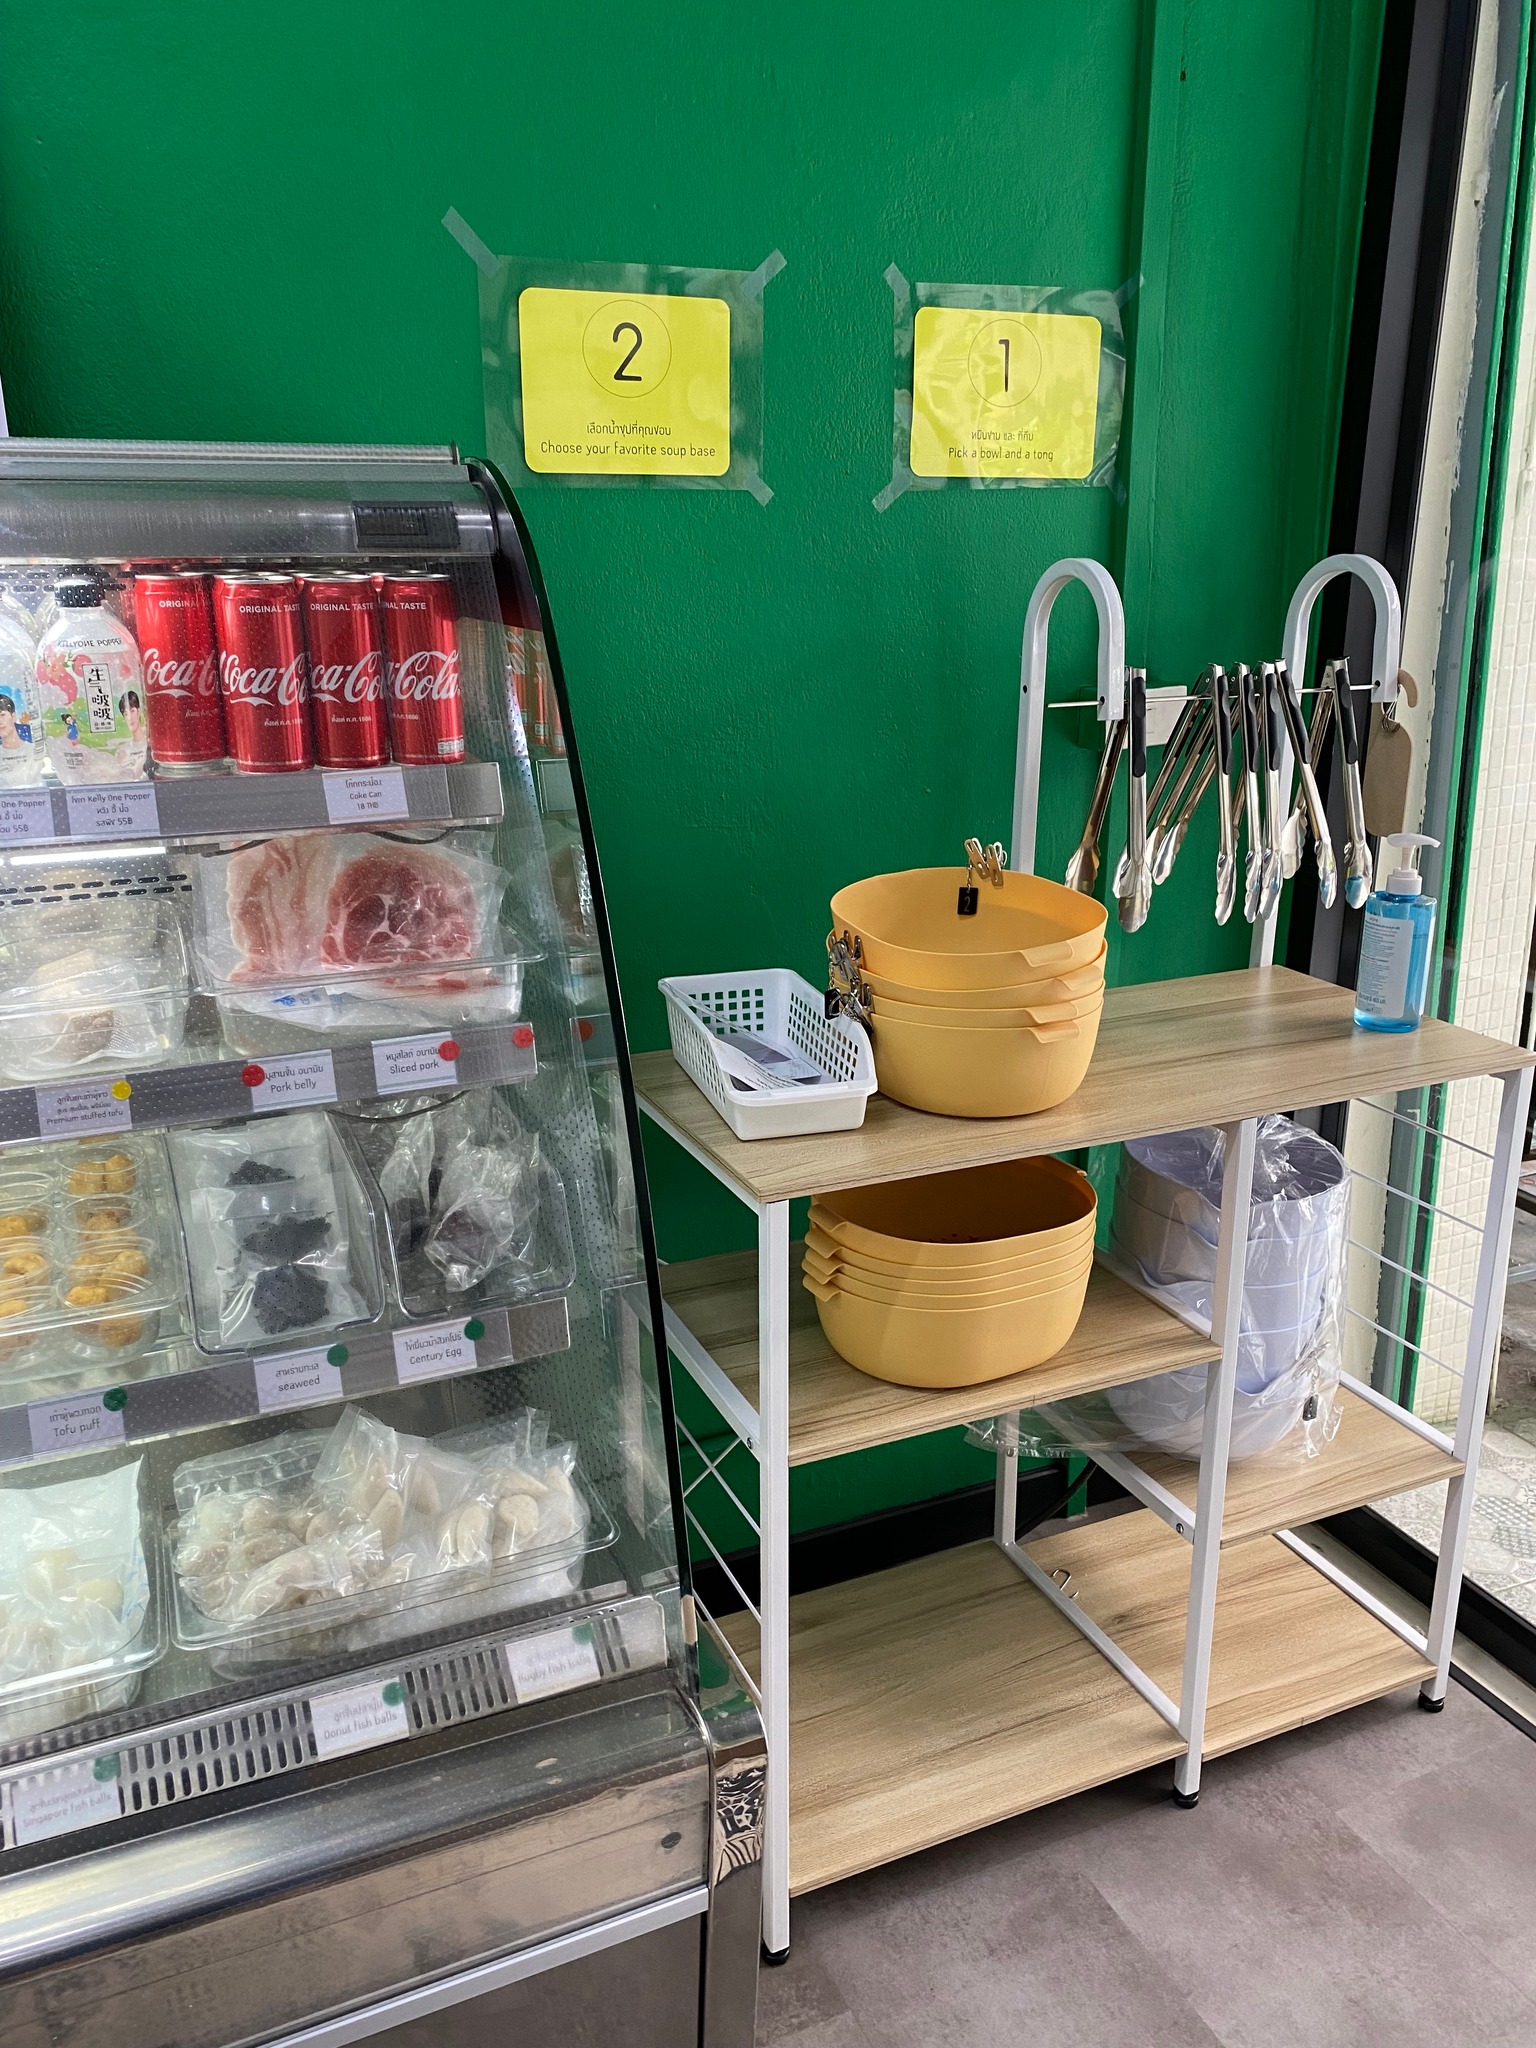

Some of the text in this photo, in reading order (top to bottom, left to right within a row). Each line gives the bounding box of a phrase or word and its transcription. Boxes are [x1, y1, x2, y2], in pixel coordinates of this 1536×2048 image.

[612, 321, 643, 382] 2
[998, 339, 1010, 392] 1
[586, 419, 672, 438] เลือกน้ำซุปที่คุณชอบ
[1003, 431, 1015, 441] และ
[540, 440, 716, 458] Choose your favorite soup base
[948, 446, 1054, 462] Pick a bowl and a tong
[239, 604, 282, 613] ORIGINAL
[310, 603, 350, 611] ORIGINAL
[352, 602, 374, 610] TASTE
[400, 602, 426, 610] TASTE
[1, 799, 47, 809] One Popper
[87, 793, 106, 804] Kelly
[108, 793, 122, 802] One
[124, 792, 151, 802] Popper
[349, 791, 368, 800] Coke
[963, 895, 971, 913] 2
[389, 1059, 440, 1076] Sliced pork
[270, 1079, 317, 1094] Pork belly
[46, 1109, 124, 1125] Premium stuffed tofu
[409, 1347, 463, 1366] Century Egg
[278, 1376, 321, 1393] seaweed
[54, 1417, 102, 1437] Tofu puff
[323, 1724, 352, 1740] Donut
[354, 1717, 373, 1732] fish
[373, 1709, 398, 1726] balls
[69, 1801, 89, 1813] fish
[90, 1791, 112, 1808] balls
